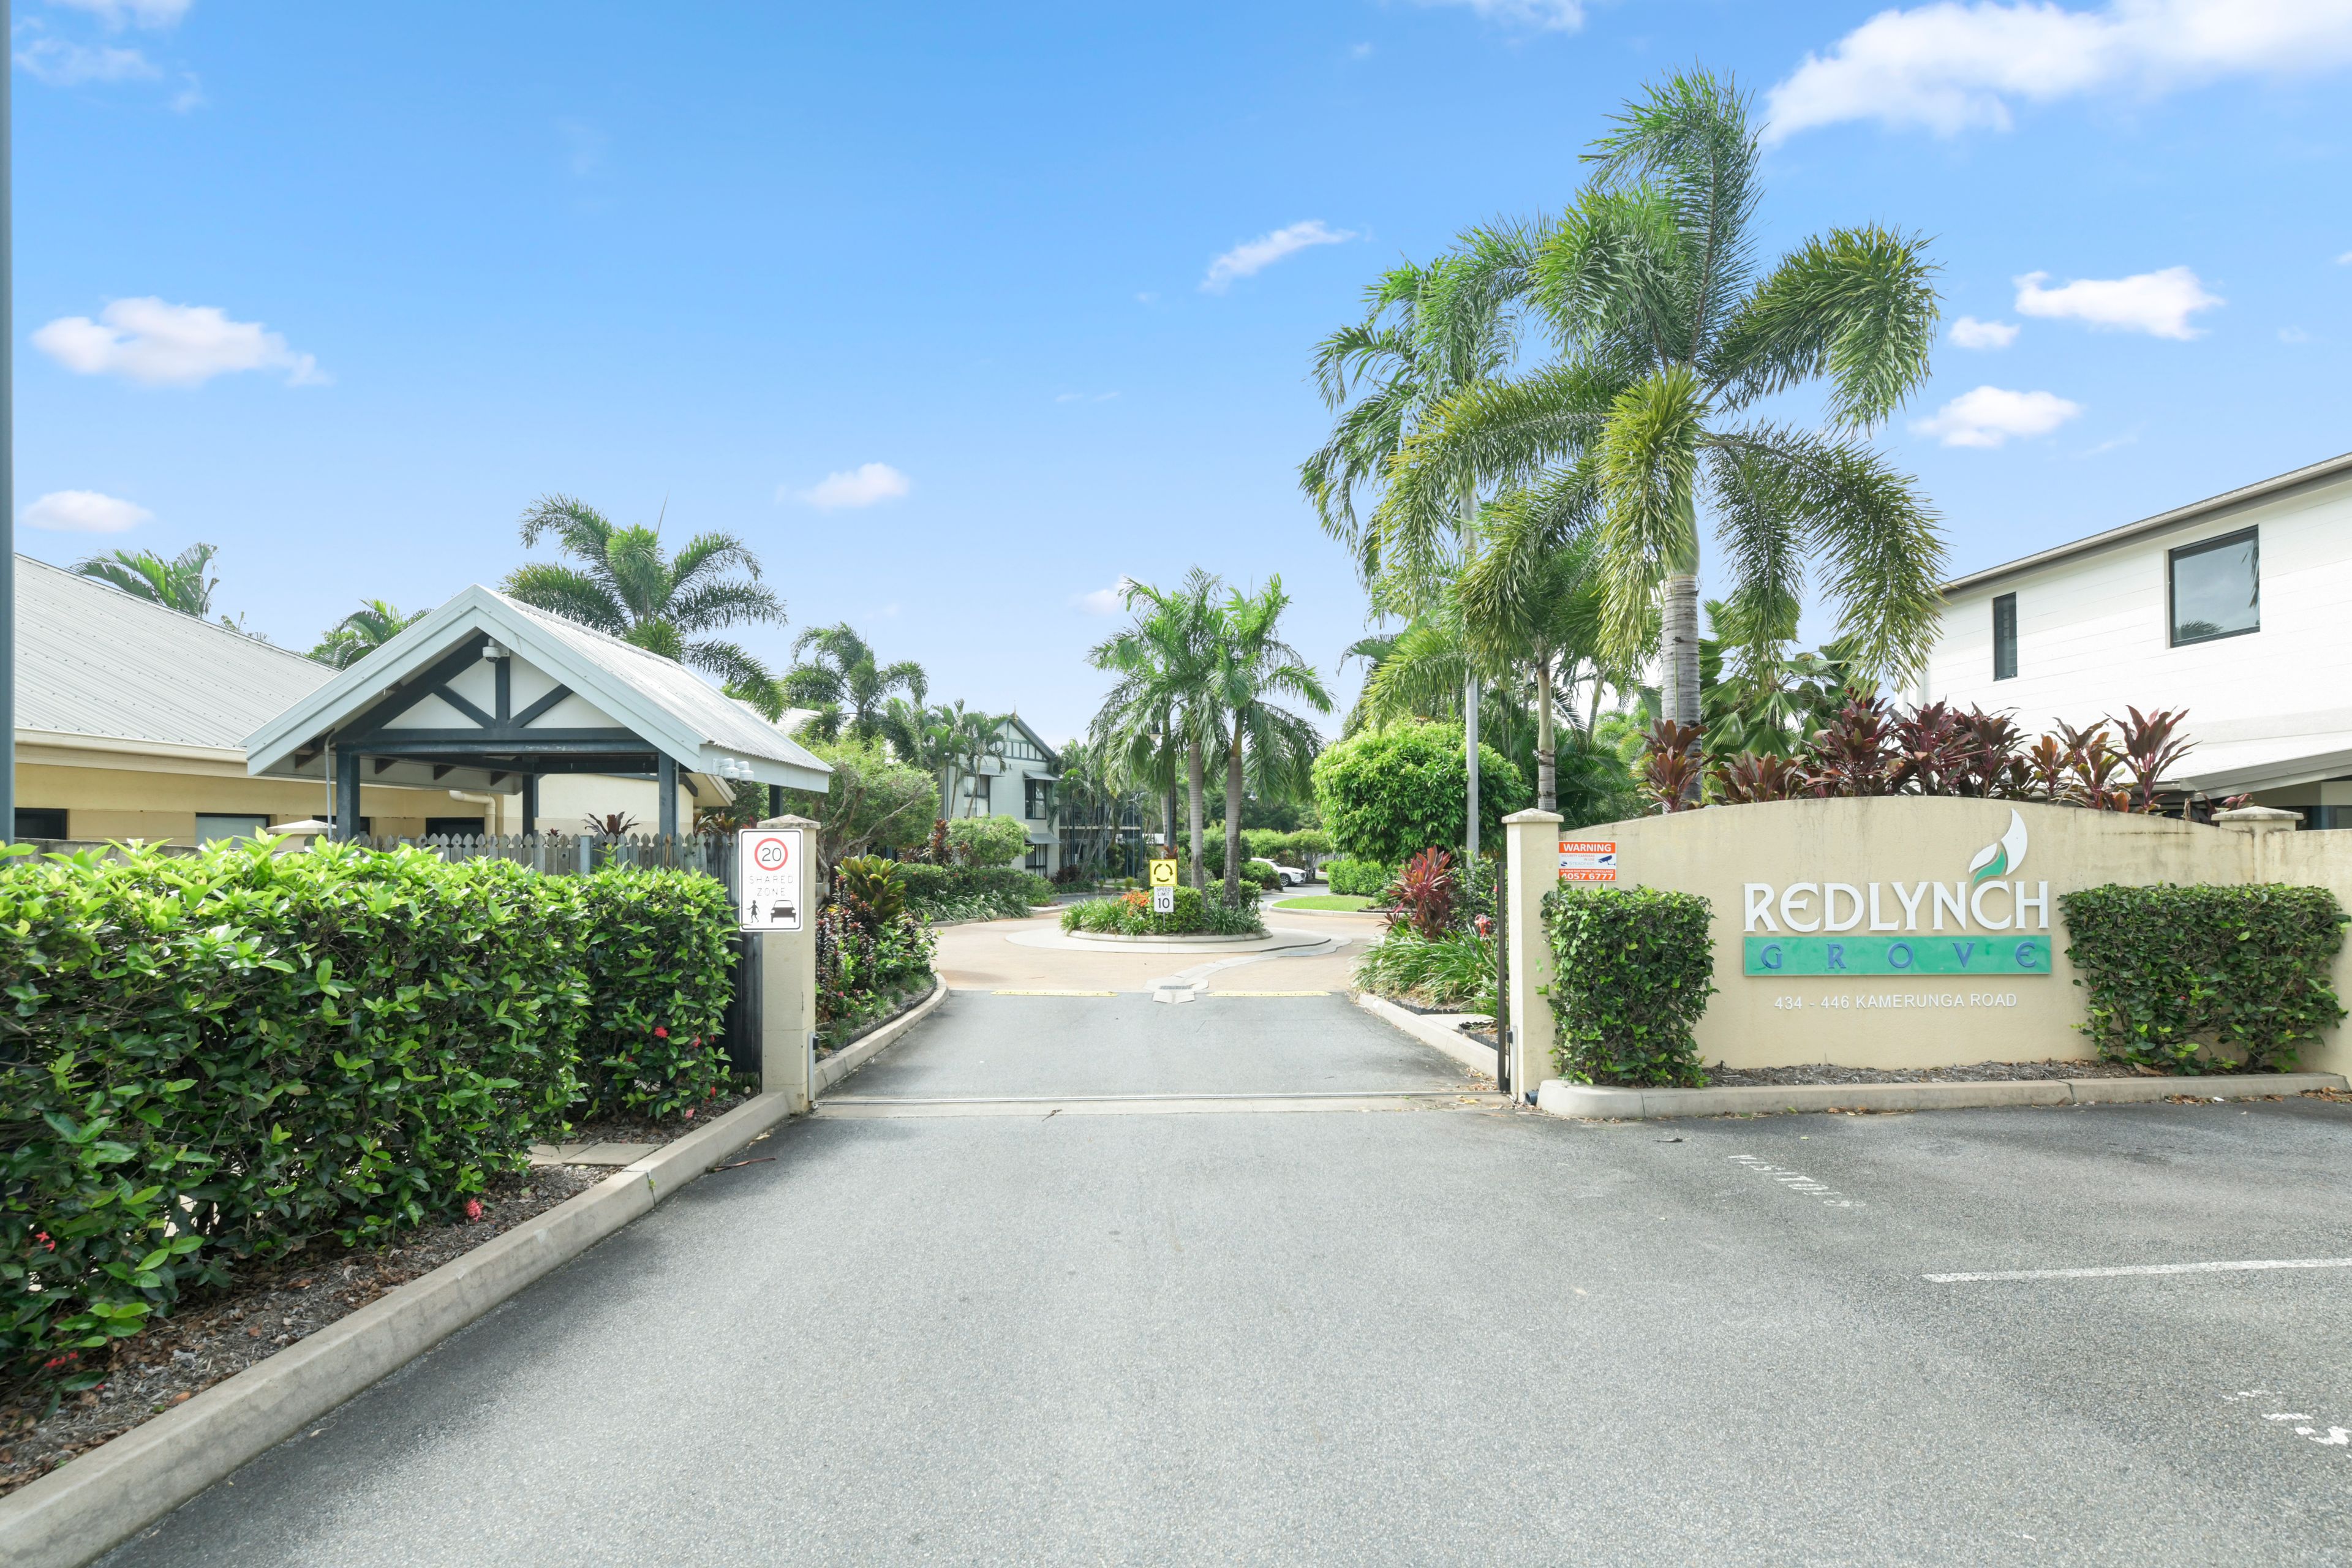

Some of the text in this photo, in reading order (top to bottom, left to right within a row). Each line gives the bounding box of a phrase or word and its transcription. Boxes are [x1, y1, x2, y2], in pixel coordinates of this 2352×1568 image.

[1563, 843, 1611, 852] WARNING
[762, 848, 782, 862] 20
[749, 875, 794, 884] SHARED
[1158, 898, 1170, 908] 10
[1743, 881, 2050, 932] REDLYNCH
[1760, 941, 2037, 970] GROVE
[1774, 997, 1802, 1010] 434
[1820, 996, 1850, 1009] 446
[1856, 994, 1964, 1009] KAMERUNGA
[1970, 993, 2018, 1007] ROAD
